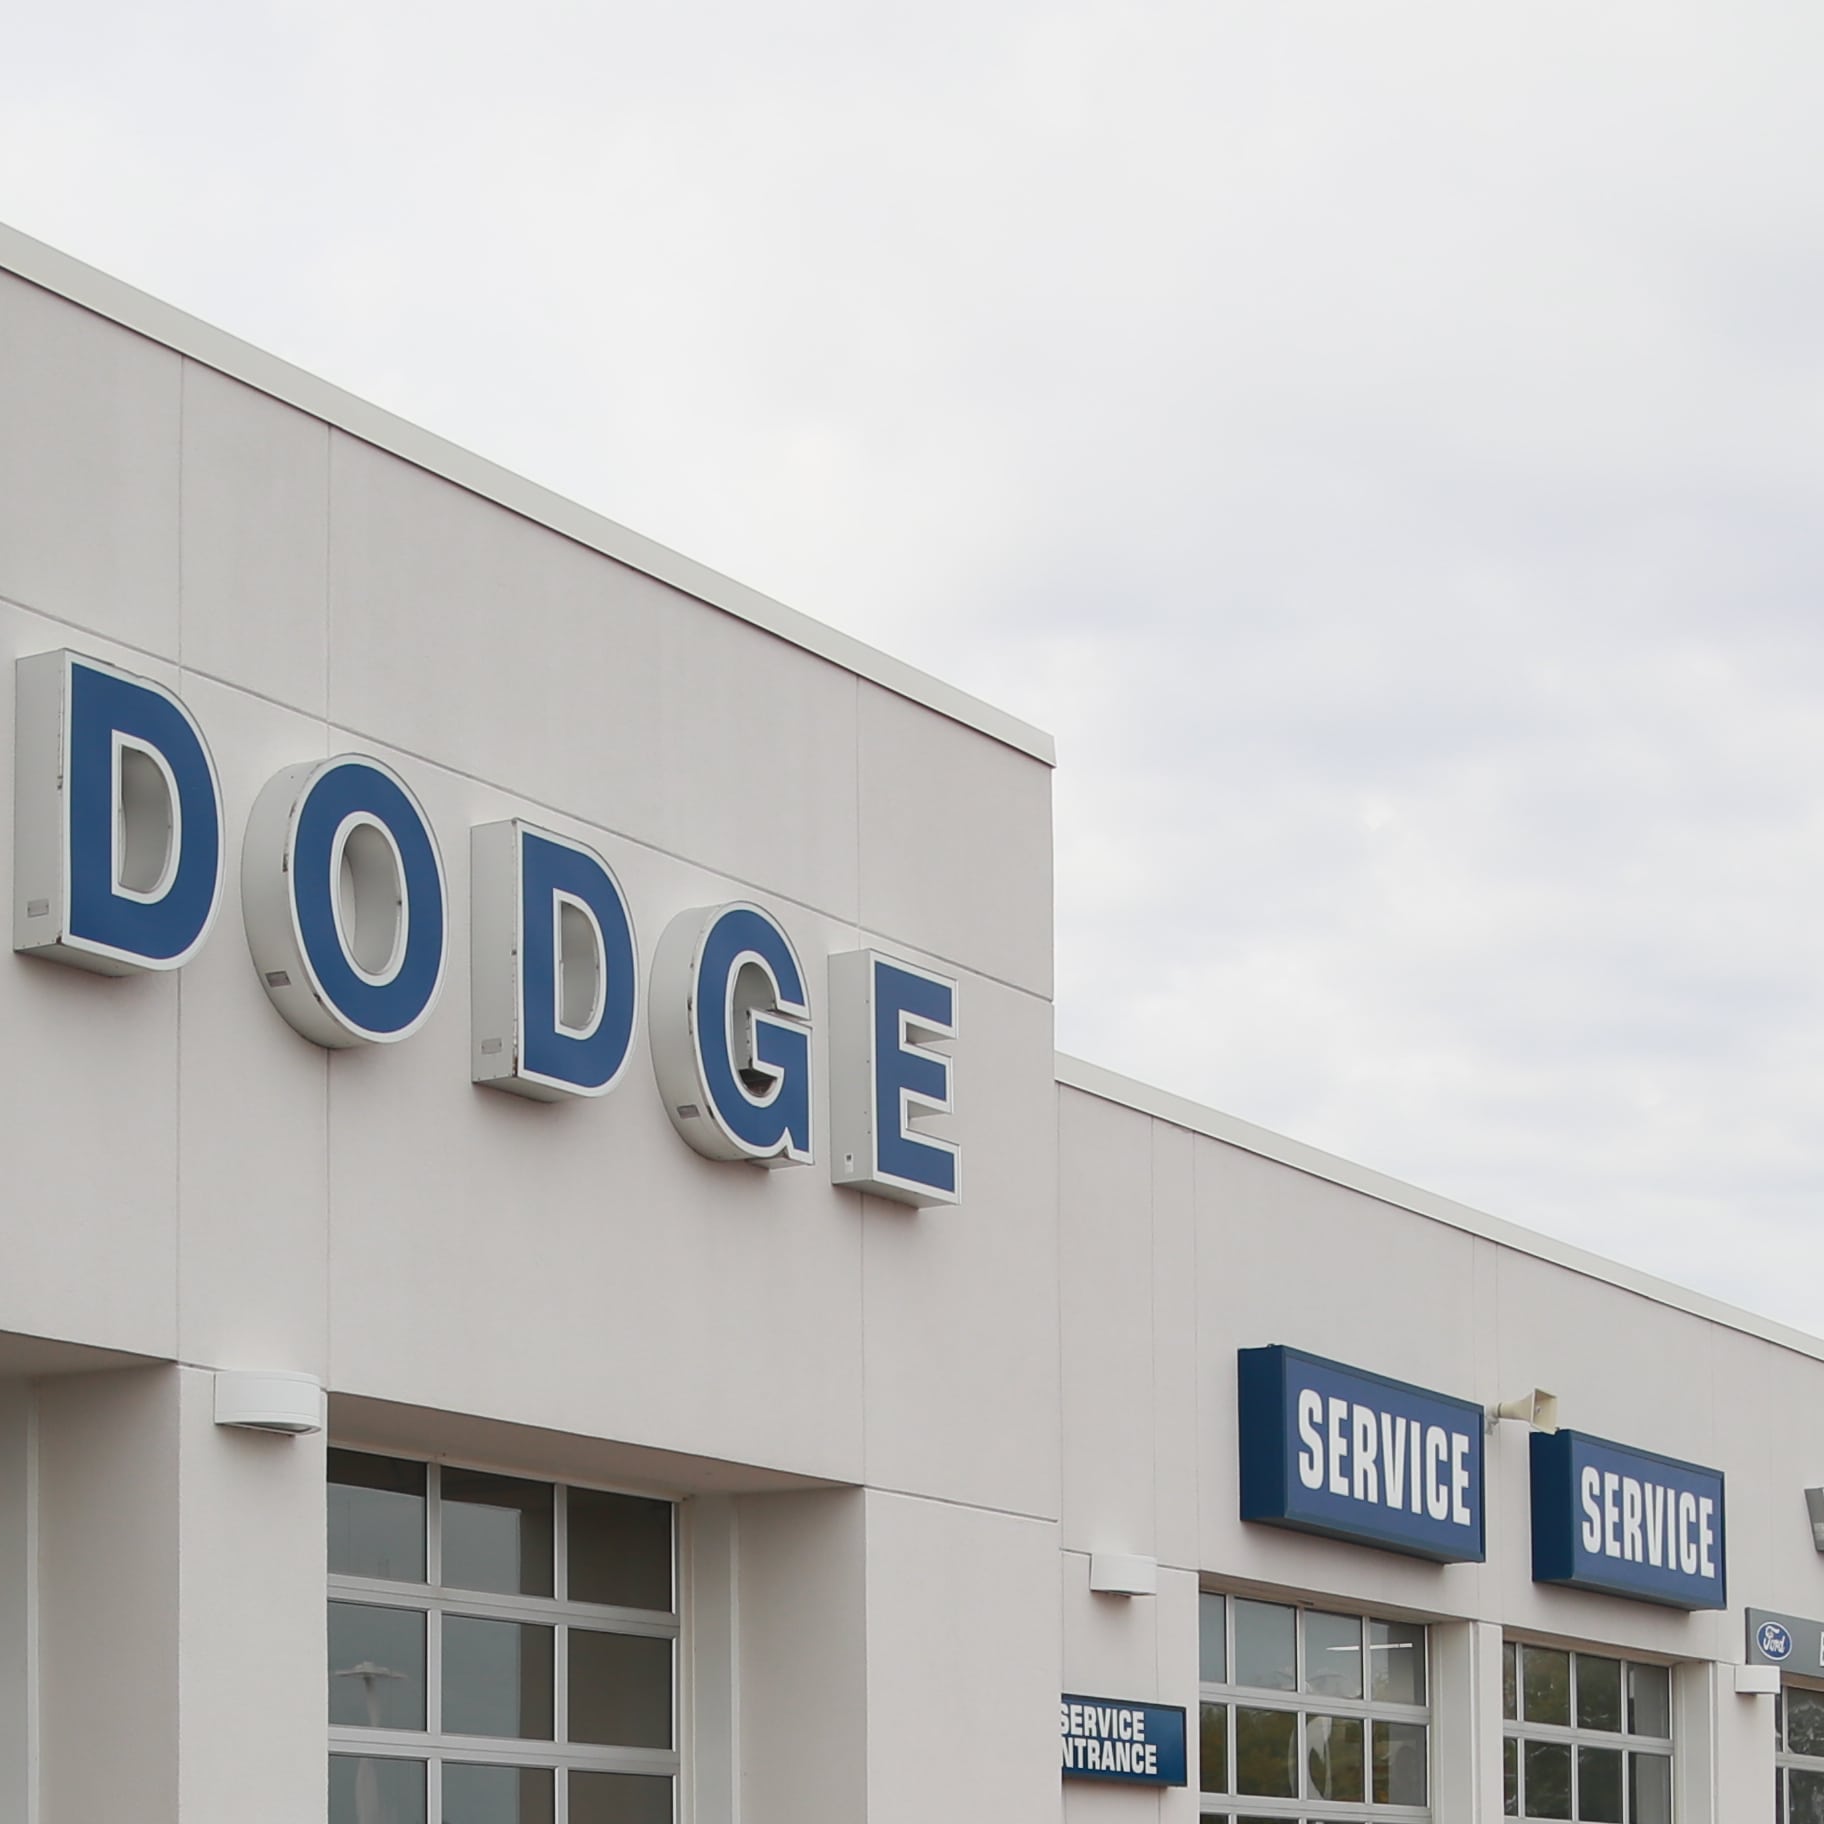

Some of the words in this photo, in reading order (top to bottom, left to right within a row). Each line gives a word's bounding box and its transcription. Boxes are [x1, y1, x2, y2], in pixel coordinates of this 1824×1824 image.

[60, 647, 961, 1207] DODGE
[1297, 1388, 1472, 1527] SERVICE
[1581, 1465, 1716, 1579] SERVICE
[1760, 1623, 1788, 1656] Ford
[1061, 1703, 1145, 1742] SERVICE
[1061, 1736, 1158, 1775] NTRANCE
